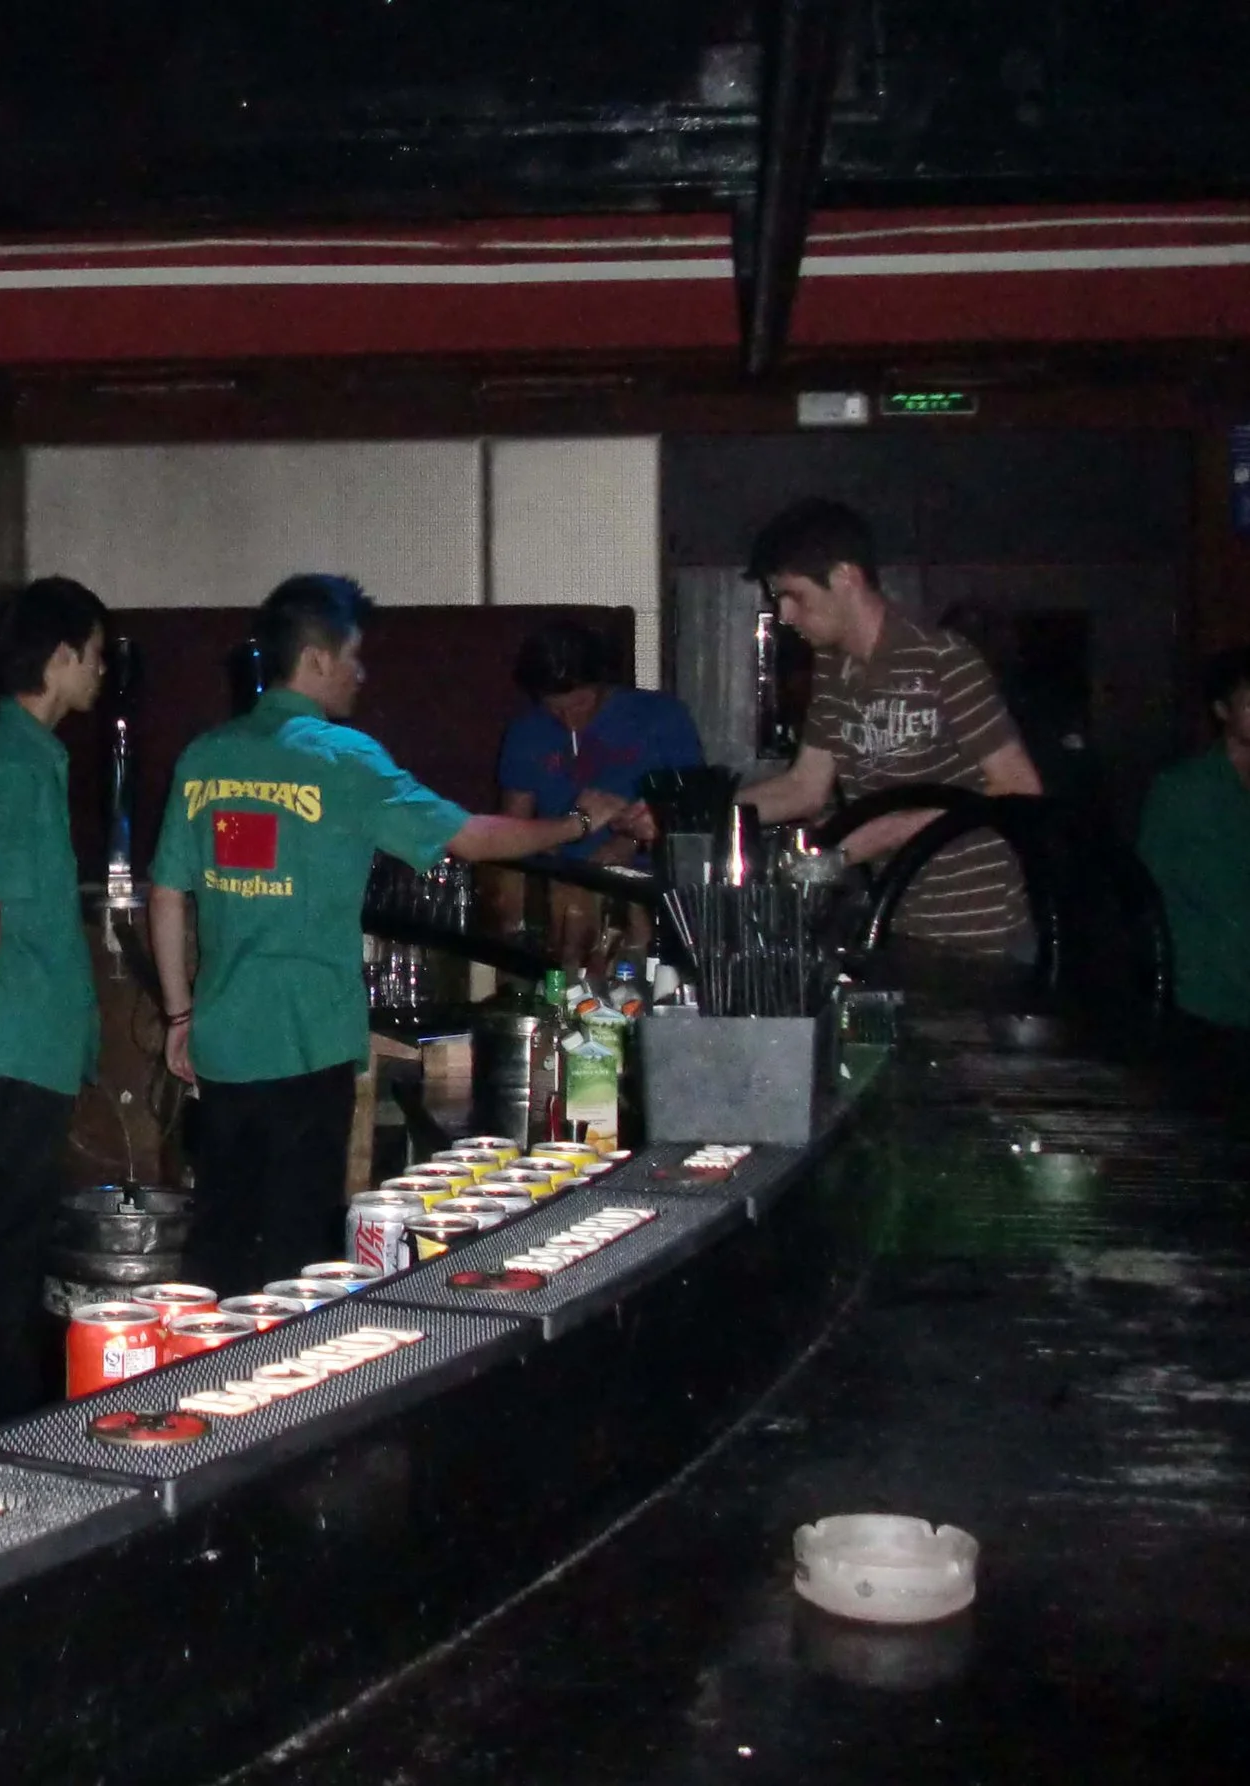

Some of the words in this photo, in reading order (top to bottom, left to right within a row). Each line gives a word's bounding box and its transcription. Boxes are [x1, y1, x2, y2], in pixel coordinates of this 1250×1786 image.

[183, 779, 323, 824] ZAPATA'S
[503, 1206, 657, 1273] BACARDI
[179, 1326, 425, 1416] BACARDI
